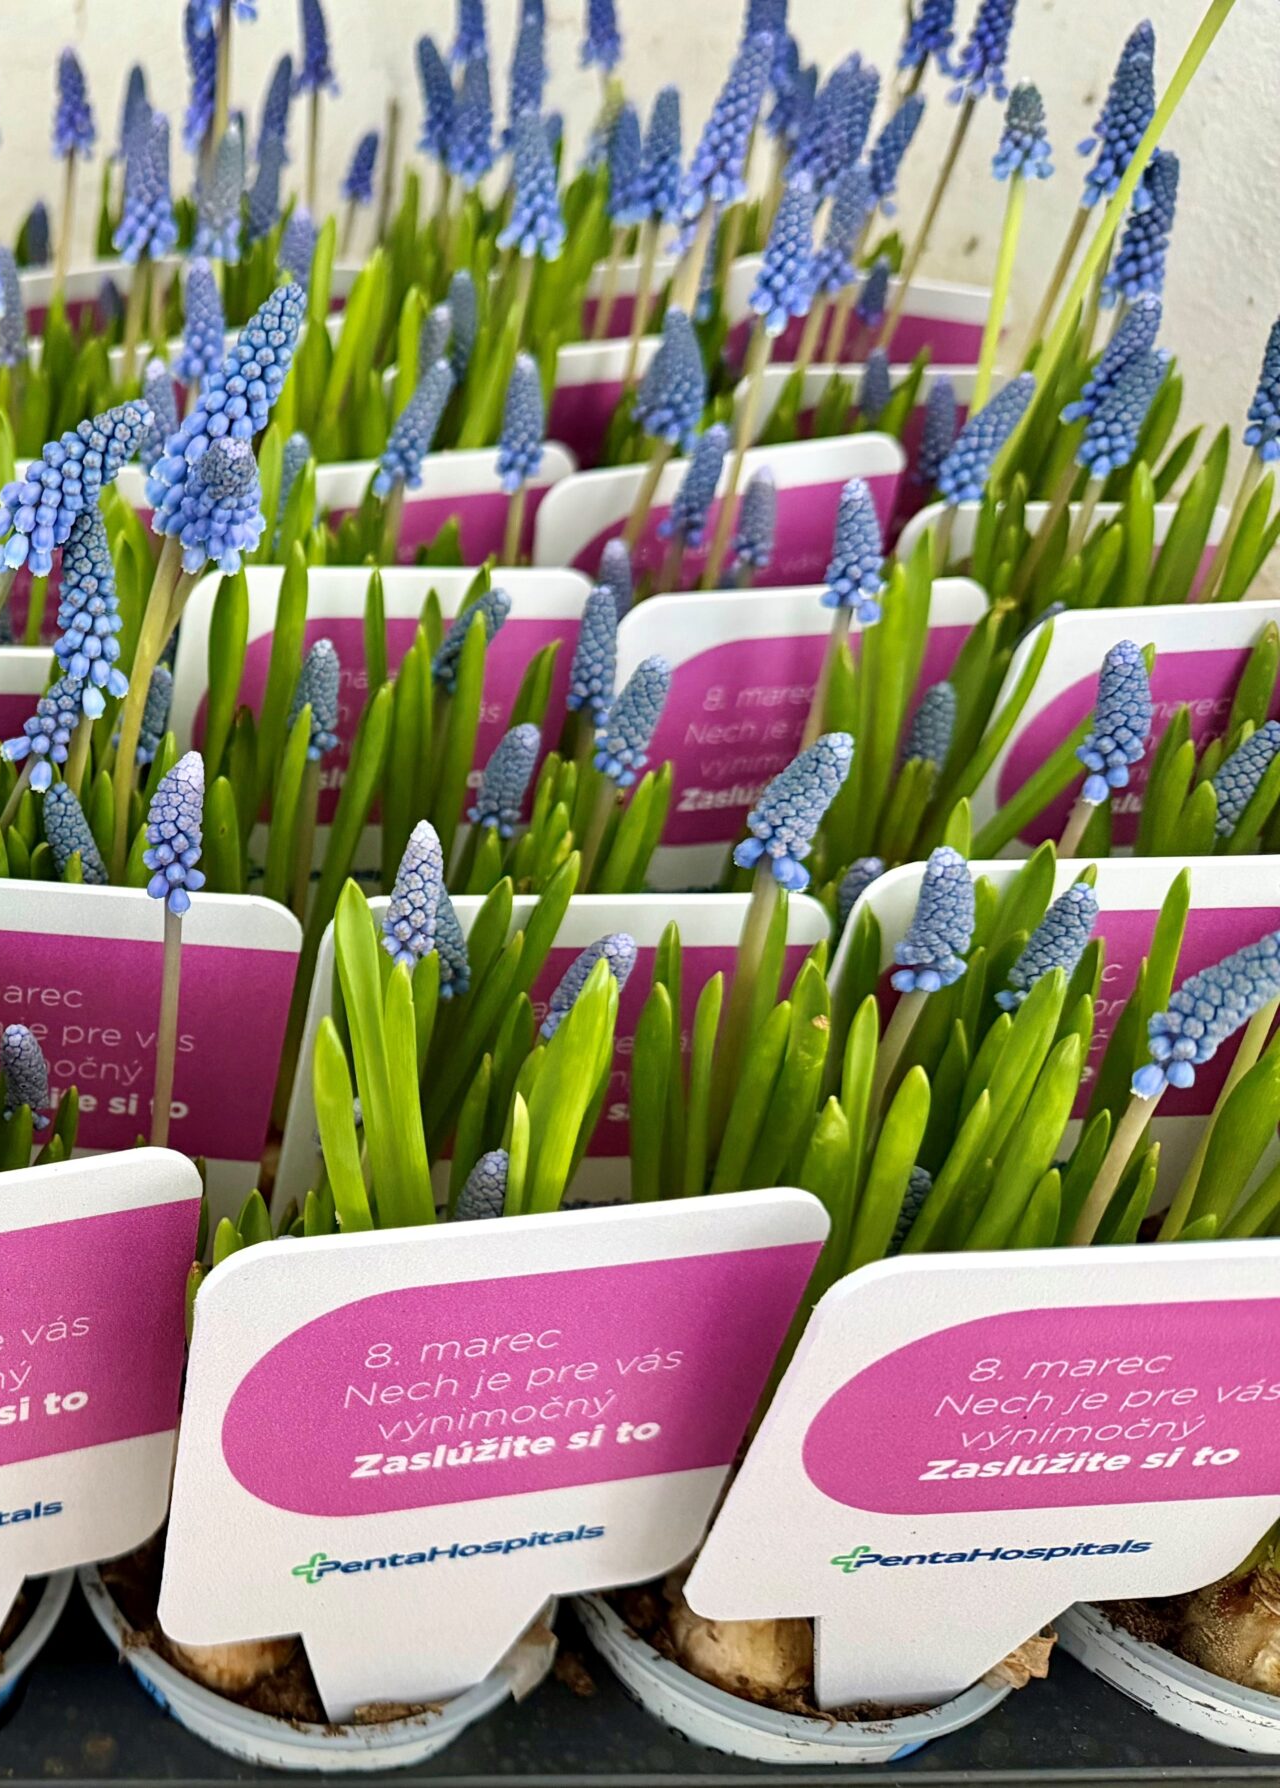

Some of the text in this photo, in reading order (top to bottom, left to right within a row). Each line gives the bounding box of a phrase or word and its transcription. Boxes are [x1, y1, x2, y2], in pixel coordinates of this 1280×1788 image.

[62, 1024, 122, 1048] pre
[135, 1031, 196, 1052] vs
[108, 1093, 139, 1117] si
[21, 1314, 91, 1346] vás
[364, 1329, 563, 1369] 8. marec
[343, 1347, 685, 1409] Nech je pre vás
[967, 1354, 1174, 1382] 8. marec
[43, 1390, 90, 1416] to
[377, 1388, 618, 1443] výnimočný
[933, 1389, 1056, 1418] Nech
[1065, 1389, 1110, 1416] je
[1118, 1386, 1200, 1413] pre
[960, 1414, 1207, 1452] výnimočný
[349, 1421, 662, 1479] Zaslúžite si to
[918, 1446, 1242, 1481] Zaslúžite si to
[317, 1524, 606, 1578] PentaHospitals
[855, 1539, 1154, 1569] PentaHospitals
